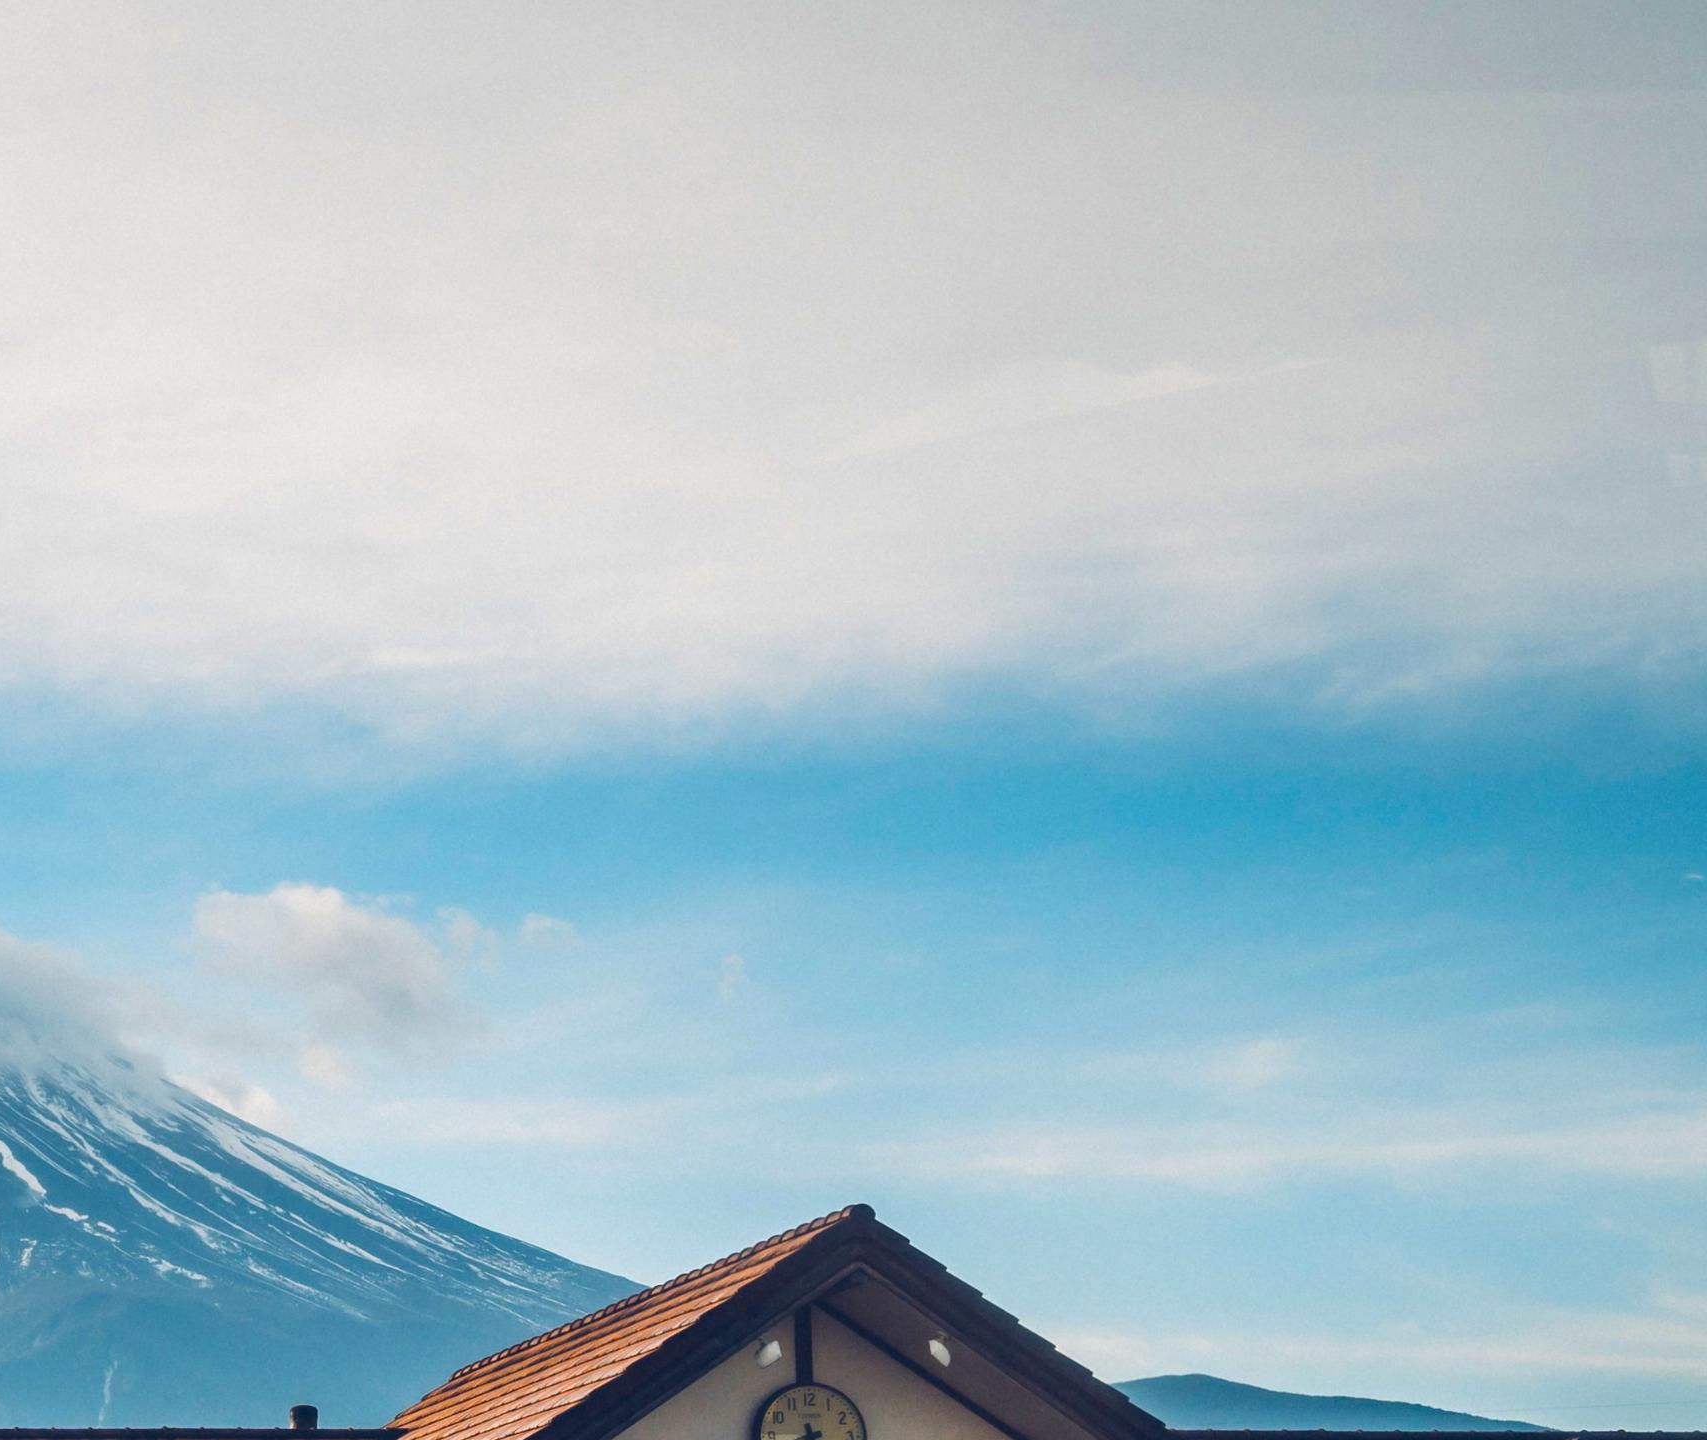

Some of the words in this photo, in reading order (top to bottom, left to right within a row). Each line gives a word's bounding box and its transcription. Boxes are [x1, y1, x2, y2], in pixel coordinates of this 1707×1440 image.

[787, 1397, 796, 1411] 11
[803, 1392, 816, 1407] 12
[826, 1398, 830, 1411] 1
[772, 1411, 784, 1424] 10
[838, 1412, 848, 1425] 2
